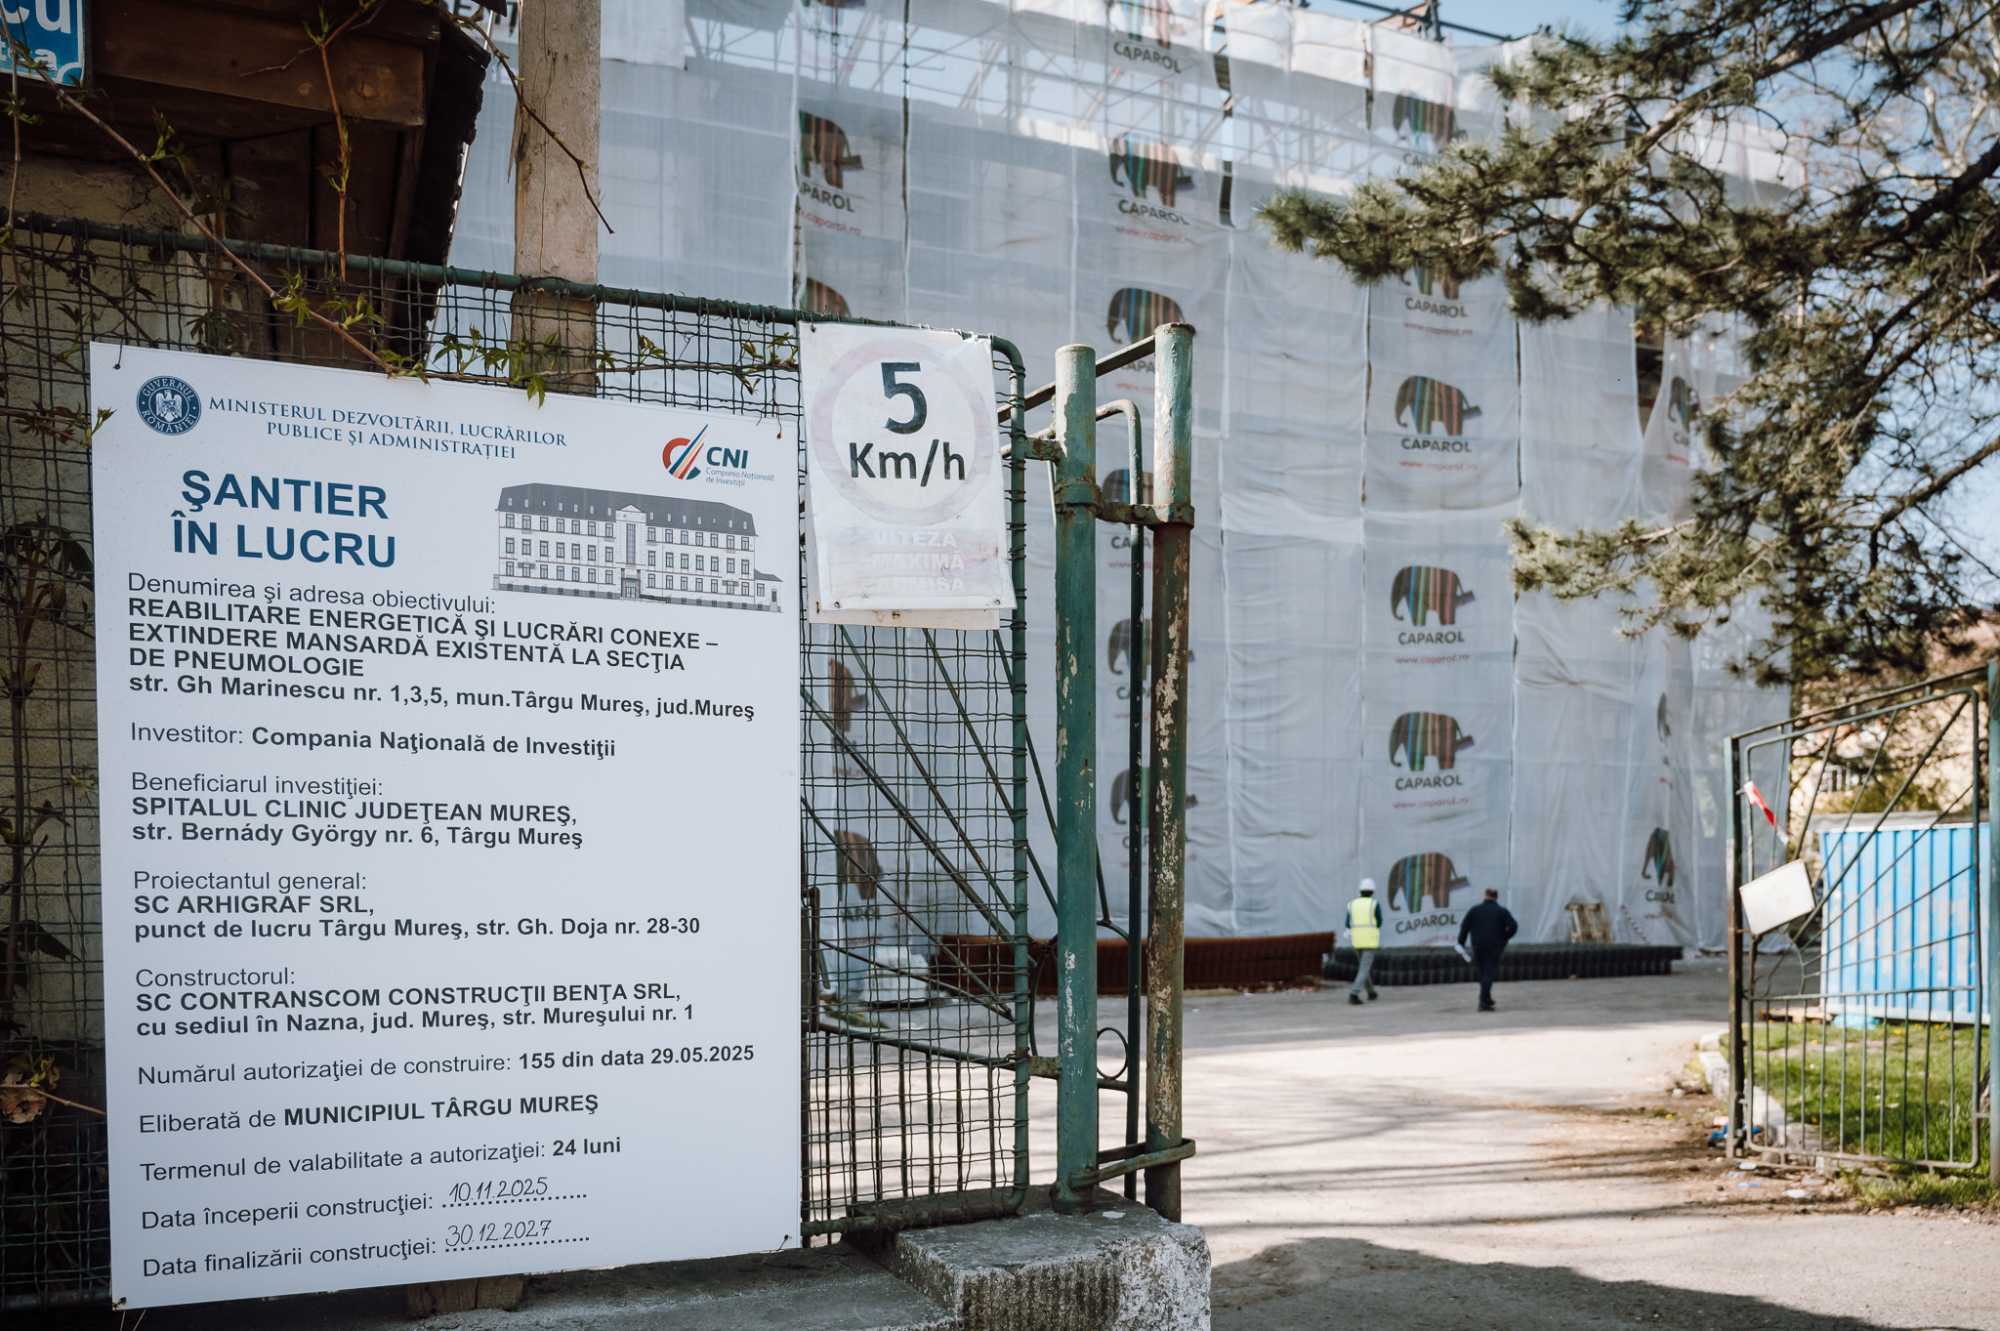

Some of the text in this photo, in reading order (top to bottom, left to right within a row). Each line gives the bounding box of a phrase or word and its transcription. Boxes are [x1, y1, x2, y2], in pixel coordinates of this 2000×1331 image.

[1113, 41, 1182, 74] CAPAROL
[1118, 199, 1190, 226] CAPAROL
[1405, 297, 1468, 318] CAPAROL
[143, 378, 195, 401] GUVERNUL
[880, 362, 927, 434] 5
[209, 396, 327, 421] MINISTERUL
[460, 423, 567, 447] LUCRĂRILOR
[267, 422, 343, 442] PUBLICE
[706, 446, 749, 469] CNI
[1401, 437, 1472, 453] CAPAROL
[849, 439, 965, 487] Km/h
[170, 509, 395, 568] ÎN LUCRU
[128, 572, 255, 599] Denumirea
[289, 584, 365, 606] adresa
[370, 589, 495, 614] obiectivului:
[129, 597, 302, 626] REABILITARE
[309, 608, 468, 636] ENERGETICĂ
[503, 620, 604, 644] LUCRĂRI
[610, 627, 700, 650] CONEXE
[1398, 631, 1465, 645] CAPAROL
[129, 622, 278, 649] EXTINDERE
[286, 631, 429, 657] MANSARDĂ
[436, 639, 566, 664] EXISTENTĂ
[572, 647, 601, 666] LA
[130, 647, 364, 677] DE PNEUMOLOGIE
[129, 673, 168, 693] str.
[177, 674, 212, 694] Gh
[221, 676, 345, 700] Marinescu
[353, 687, 382, 702] nr.
[390, 684, 448, 708] 1,3,5,
[456, 690, 573, 714] mun.Târgu
[131, 722, 243, 745] Investitor:
[252, 726, 372, 751] Compania
[492, 735, 519, 753] de
[132, 771, 267, 793] Beneficiarul
[1395, 775, 1464, 791] CAPAROL
[132, 796, 258, 817] SPITALUL
[264, 799, 347, 819] CLINIC
[132, 822, 173, 841] str.
[181, 822, 284, 846] Bernády
[291, 824, 378, 848] György
[385, 829, 413, 843] nr.
[421, 826, 439, 847] 6,
[446, 826, 510, 849] Târgu
[134, 871, 366, 895] Proiectantul general:
[134, 895, 374, 917] SC ARHIGRAF SRL,
[135, 920, 207, 943] punct
[213, 919, 243, 938] de
[251, 919, 311, 938] lucru
[318, 918, 386, 941] Târgu
[476, 919, 510, 936] str.
[517, 918, 553, 935] Gh.
[561, 918, 608, 939] Doja
[615, 921, 640, 934] nr.
[646, 917, 700, 934] 28-30
[1395, 913, 1457, 934] CAPAROL
[136, 967, 295, 988] Constructorul:
[136, 993, 172, 1012] SC
[180, 988, 380, 1011] CONTRANSCOM
[633, 983, 680, 1002] SRL,
[136, 1022, 166, 1036] cu
[175, 1015, 248, 1035] sediul
[256, 1014, 278, 1033] în
[287, 1014, 365, 1033] Nazna,
[370, 1011, 414, 1034] jud.
[502, 1009, 536, 1026] str.
[652, 1008, 677, 1021] nr.
[684, 1004, 692, 1020] 1
[138, 1063, 235, 1085] Numărul
[370, 1058, 397, 1076] de
[403, 1054, 511, 1075] construire:
[519, 1052, 555, 1070] 155
[562, 1051, 594, 1068] din
[600, 1049, 644, 1066] data
[650, 1044, 754, 1064] 29.05.2025
[139, 1110, 241, 1133] Eliberată
[248, 1109, 276, 1128] de
[284, 1102, 425, 1126] MUNICIPIUL
[430, 1096, 512, 1119] TÂRGU
[139, 1157, 246, 1181] Termenul
[254, 1156, 281, 1175] de
[288, 1150, 403, 1176] valabilitate
[410, 1152, 423, 1168] a
[552, 1138, 577, 1157] 24
[584, 1136, 620, 1155] luni
[142, 1210, 196, 1230] Data
[203, 1201, 298, 1226] începerii
[143, 1257, 197, 1277] Data
[204, 1247, 302, 1272] finalizării
